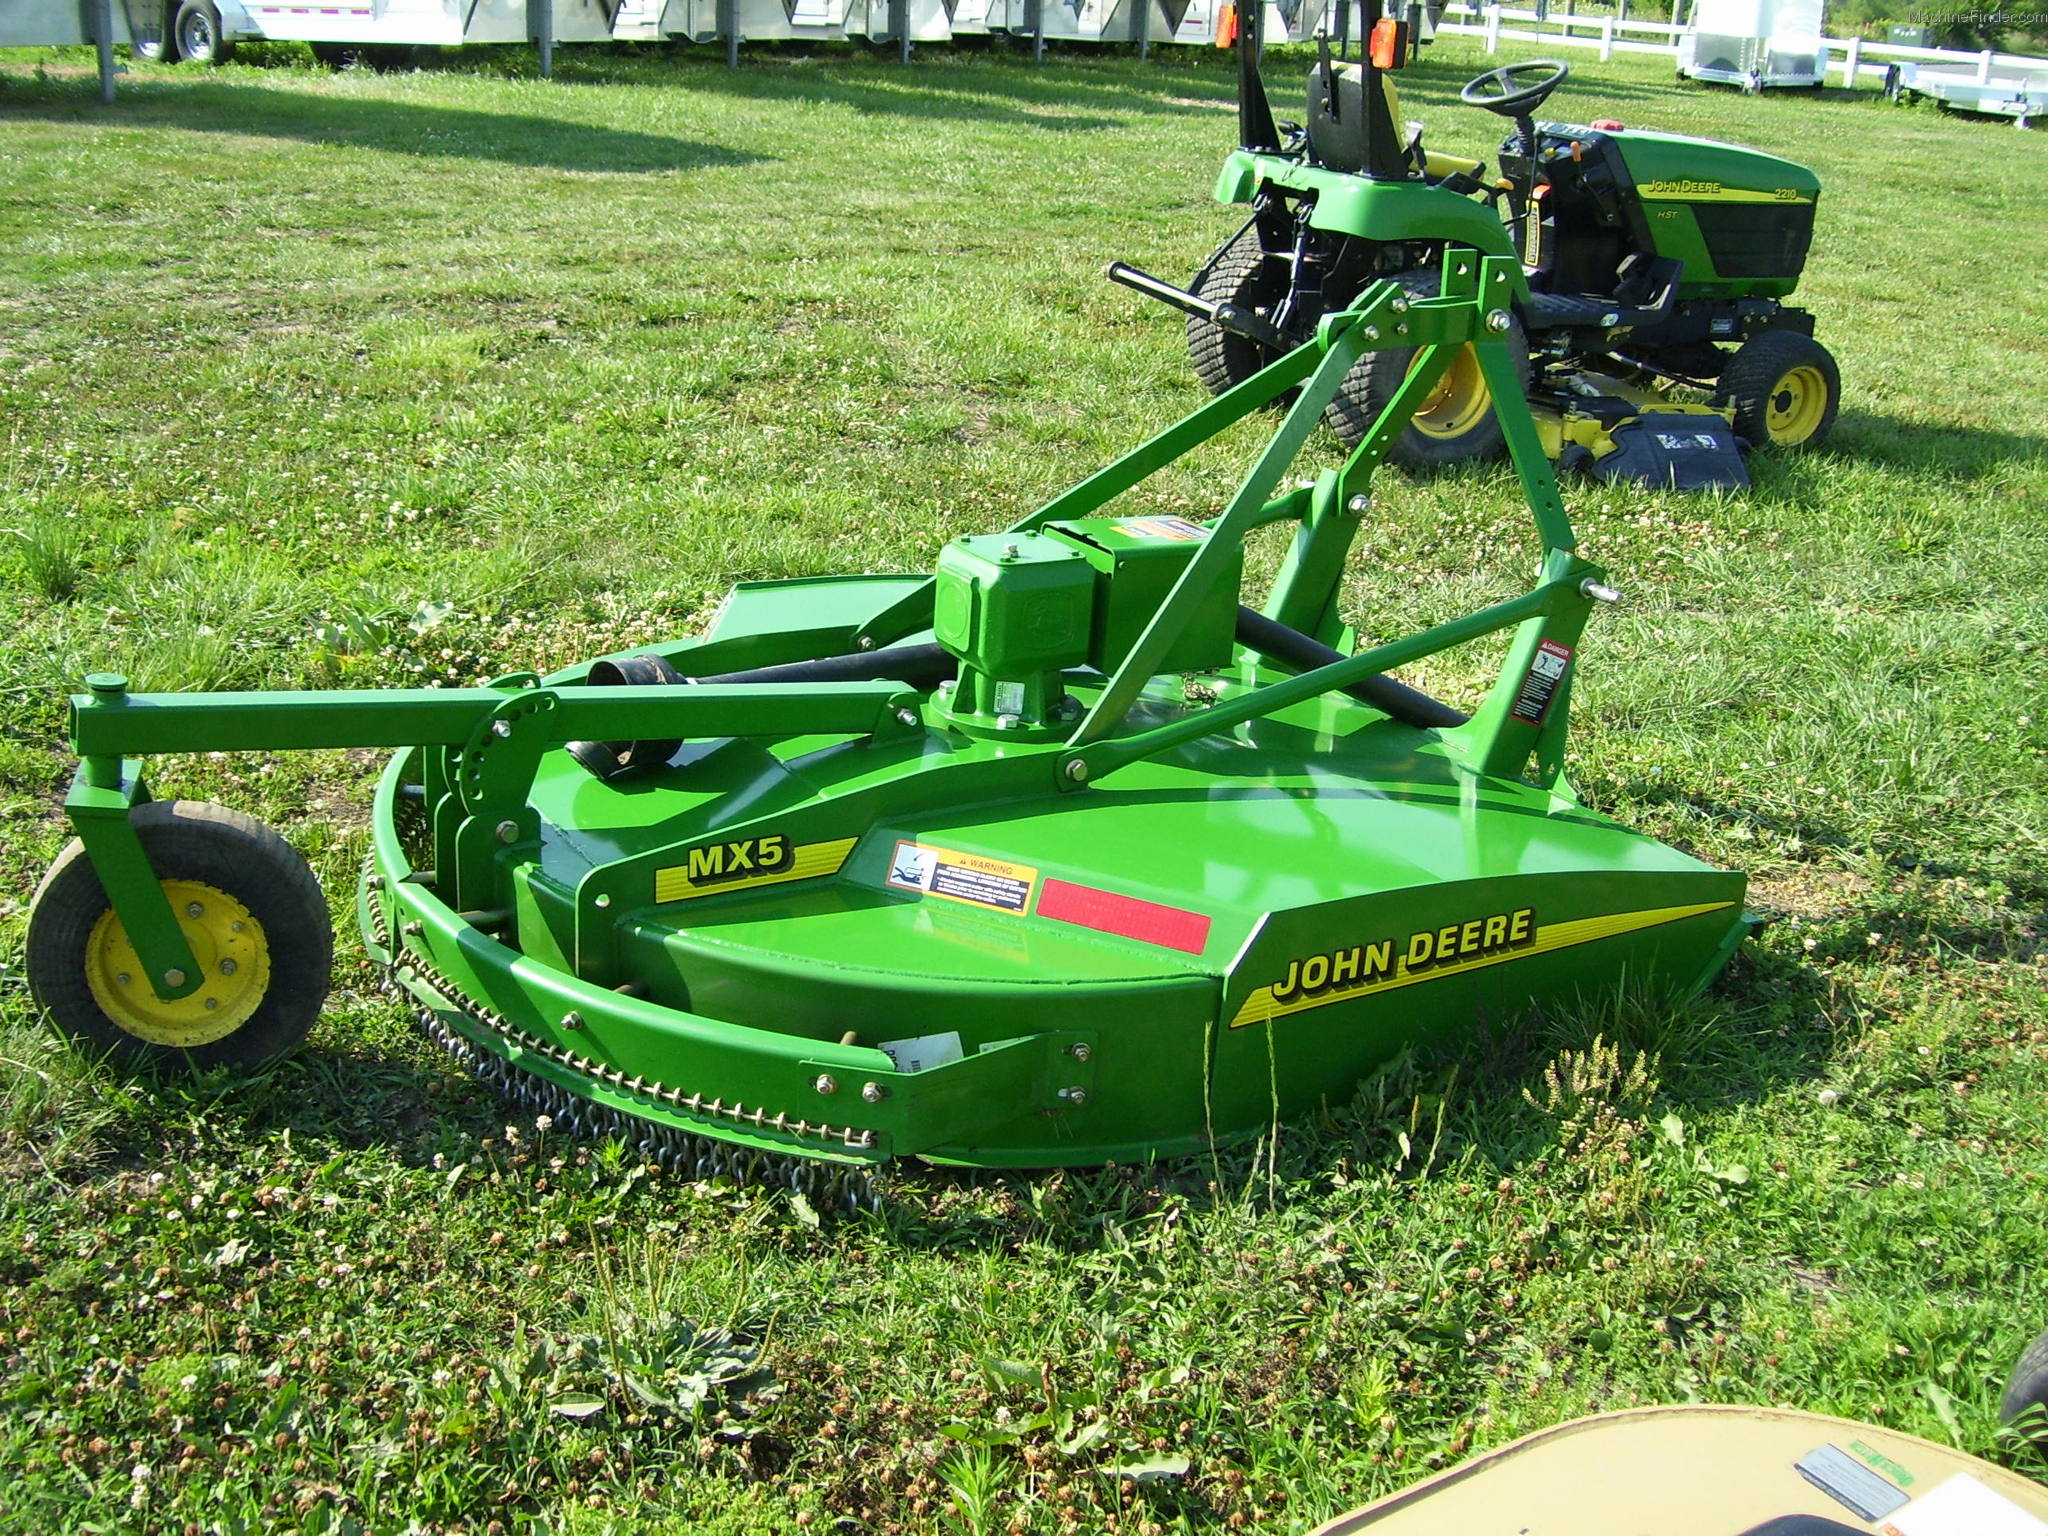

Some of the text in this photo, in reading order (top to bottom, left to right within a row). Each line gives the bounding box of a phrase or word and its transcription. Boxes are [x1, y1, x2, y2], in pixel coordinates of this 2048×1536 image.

[1648, 179, 1798, 200] JOHN DEERE 2210
[1656, 210, 1679, 219] HST
[688, 834, 790, 884] MX5
[969, 858, 1014, 875] WARNING
[1271, 907, 1534, 1000] JOHN DEERE
